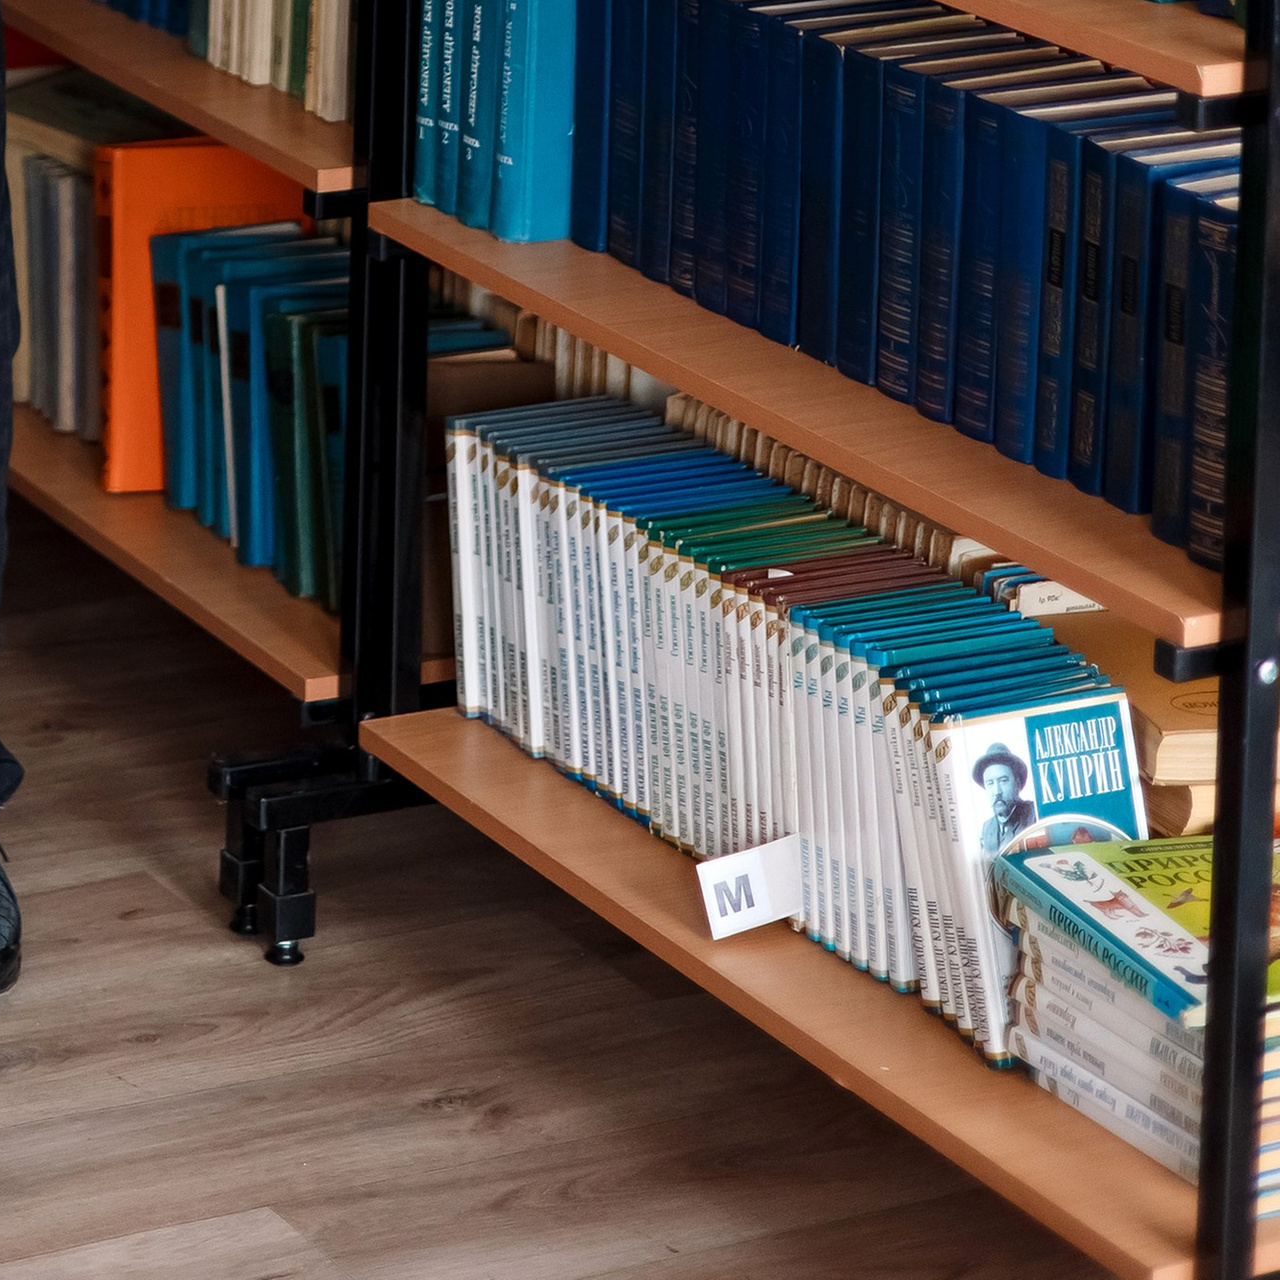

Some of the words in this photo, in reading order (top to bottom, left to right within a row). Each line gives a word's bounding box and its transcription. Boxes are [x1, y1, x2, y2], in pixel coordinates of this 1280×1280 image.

[472, 4, 482, 42] БЛОК
[420, 26, 432, 106] АЛЕКСАНДР
[442, 32, 454, 113] АЛЕКСАНДР
[468, 46, 480, 127] АЛЕКСАНДР
[441, 131, 450, 144] 2
[643, 576, 651, 637] Стихотворения
[655, 588, 664, 649] Стихотворения
[670, 595, 680, 657] Стихотворения
[686, 603, 695, 665] Стихотворения
[699, 611, 709, 673] Стихотворения
[715, 622, 723, 684] Стихотворения
[793, 670, 804, 691] Мы
[808, 677, 818, 698] Мы
[822, 690, 832, 710] Мы
[649, 703, 658, 746] АФАНАСИЙ
[674, 701, 682, 719] ФЕТ
[689, 711, 698, 729] ФЕТ
[838, 696, 848, 716] Мы
[854, 706, 866, 726] Мы
[872, 714, 883, 735] Мы
[661, 714, 670, 758] АФАНАСИЙ
[674, 722, 684, 765] АФАНАСИЙ
[703, 719, 711, 736] ФЕТ
[890, 726, 902, 758] рассказы
[1035, 716, 1117, 760] АЛЕКСАНДР
[690, 732, 699, 775] АФАНАСИЙ
[703, 739, 712, 783] АФАНАСИЙ
[719, 750, 727, 794] АФАНАСИЙ
[895, 768, 903, 794] Повести
[945, 773, 956, 805] рассказы
[1037, 749, 1126, 805] КУПРИН
[950, 815, 959, 842] Повести
[1106, 852, 1213, 874] ПРИРО
[1122, 868, 1212, 890] РОСС
[713, 874, 756, 918] М
[908, 887, 921, 928] КУПРИН
[927, 900, 942, 942] КУПРИН
[942, 915, 957, 956] КУПРИН
[912, 932, 928, 992] АЛЕКСАНДР
[956, 926, 970, 967] КУПРИН
[966, 937, 980, 979] КУПРИН
[1049, 904, 1102, 963] ПРИРОДА
[1102, 946, 1150, 995] РОССИИ
[933, 945, 950, 1006] АЛЕКСАНДР
[950, 960, 965, 1021] АЛЕКСАНДР
